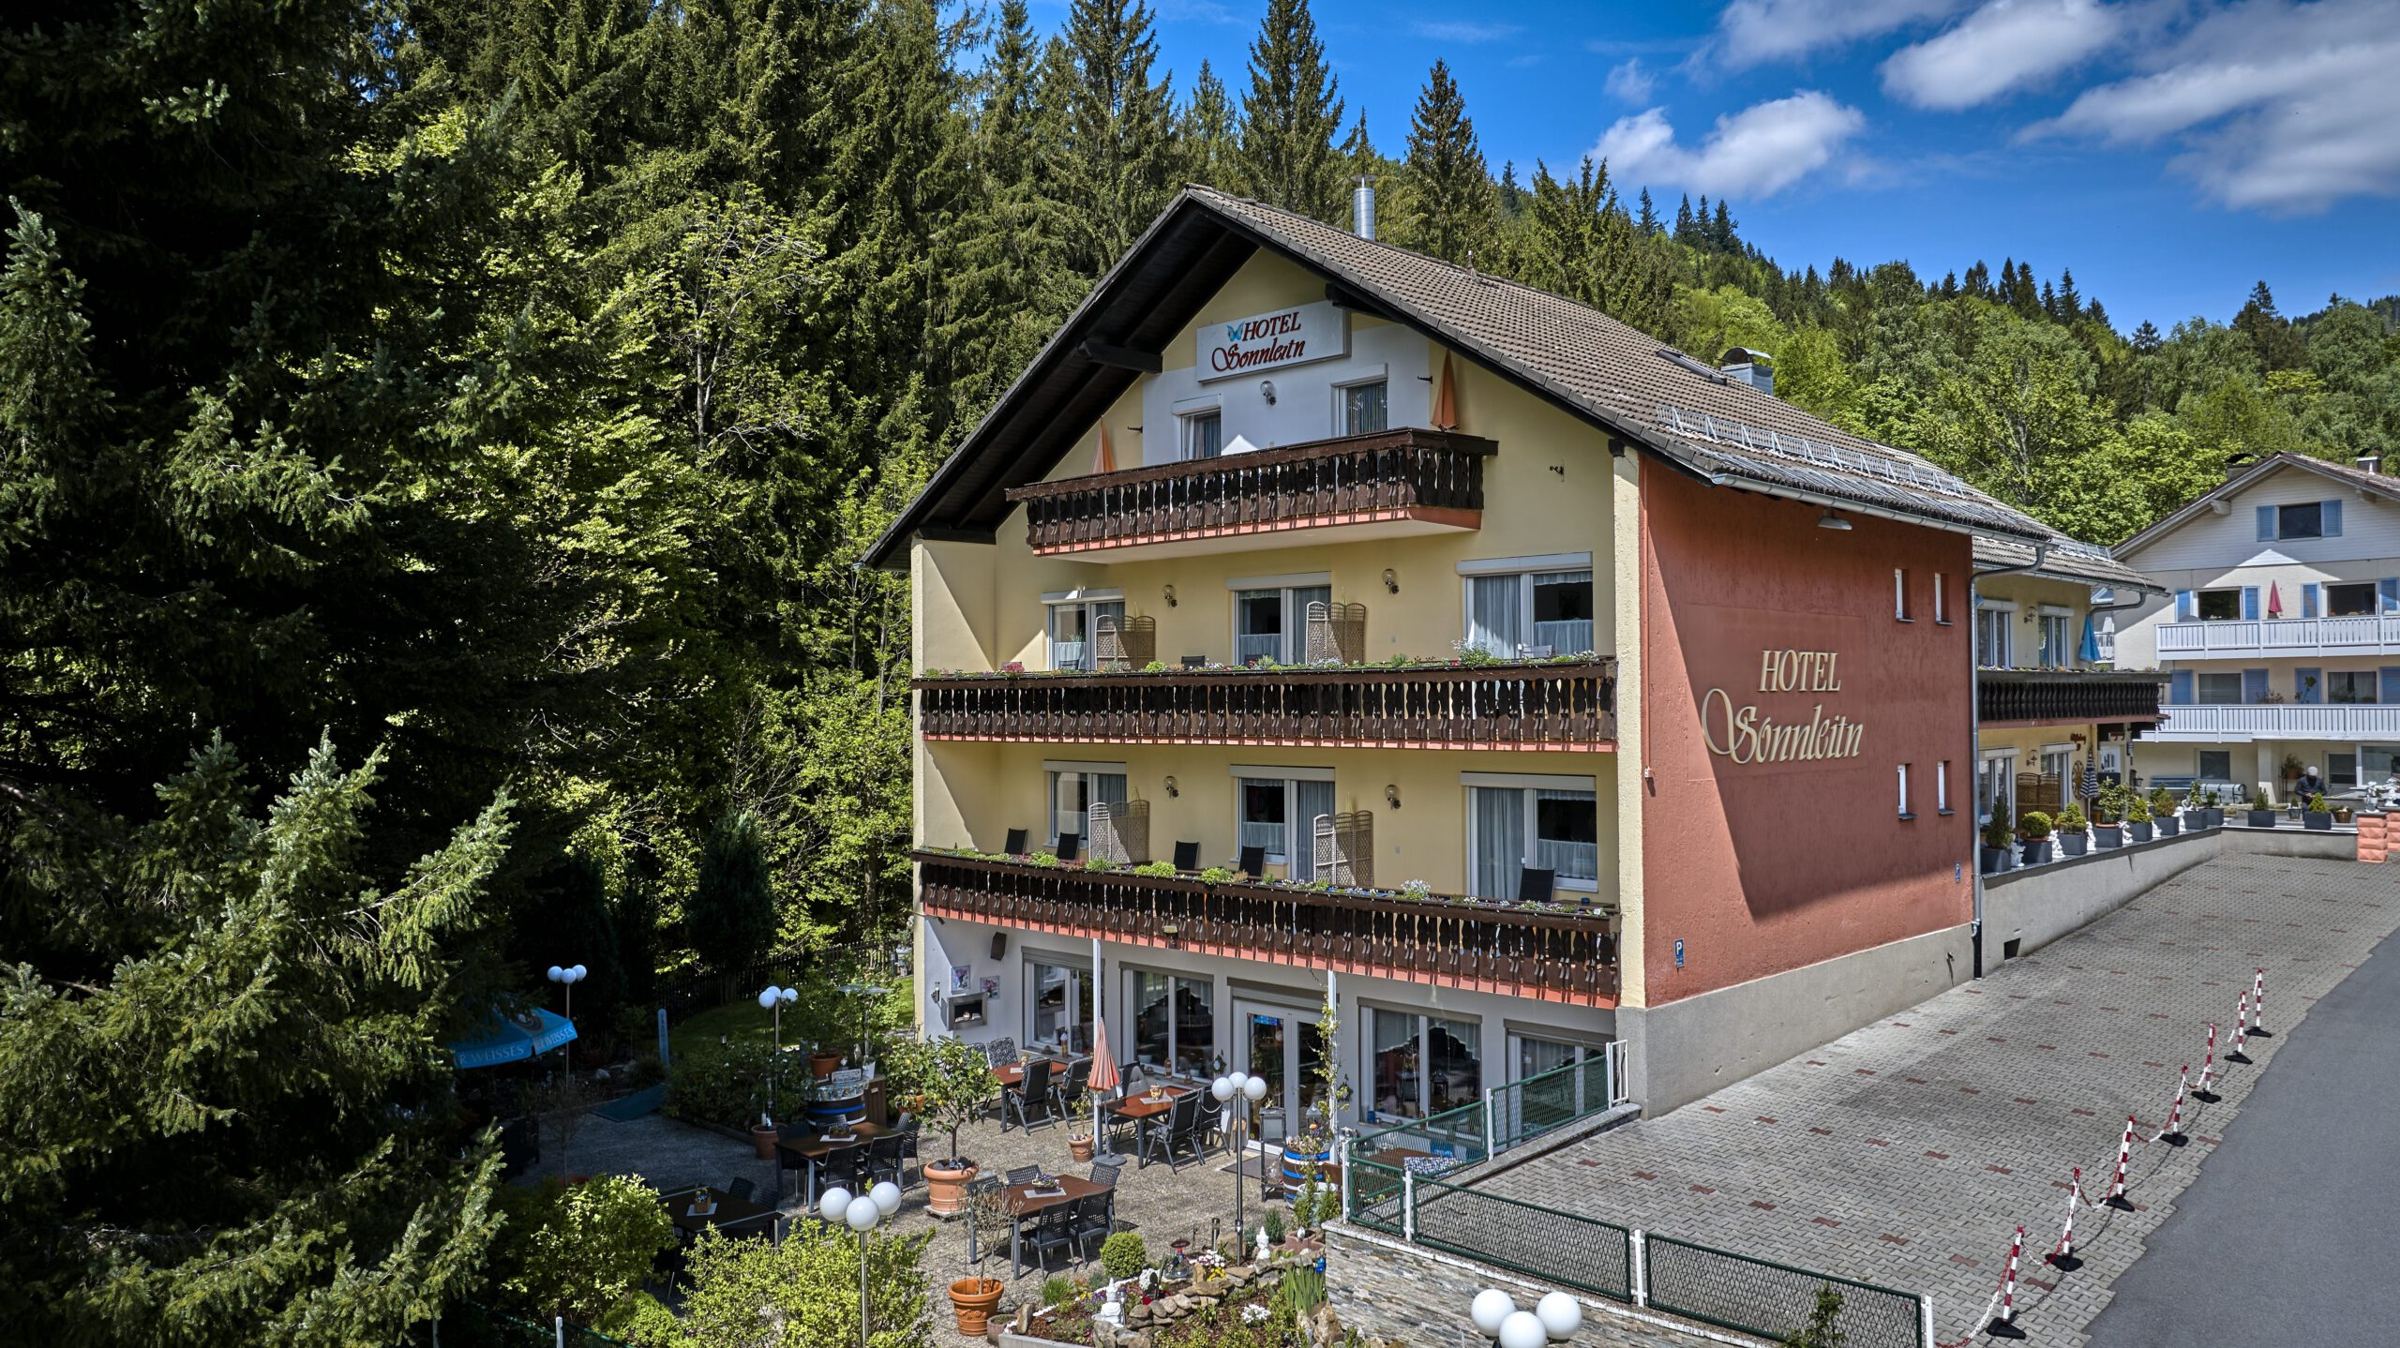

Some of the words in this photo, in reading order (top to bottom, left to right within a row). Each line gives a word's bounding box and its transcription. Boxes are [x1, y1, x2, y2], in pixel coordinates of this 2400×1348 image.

[1241, 311, 1302, 342] HOTEL
[1211, 338, 1306, 372] Sonnleitn
[1759, 649, 1841, 692] HOTEL
[1701, 688, 1864, 764] Sonnleitn
[1676, 941, 1683, 955] P
